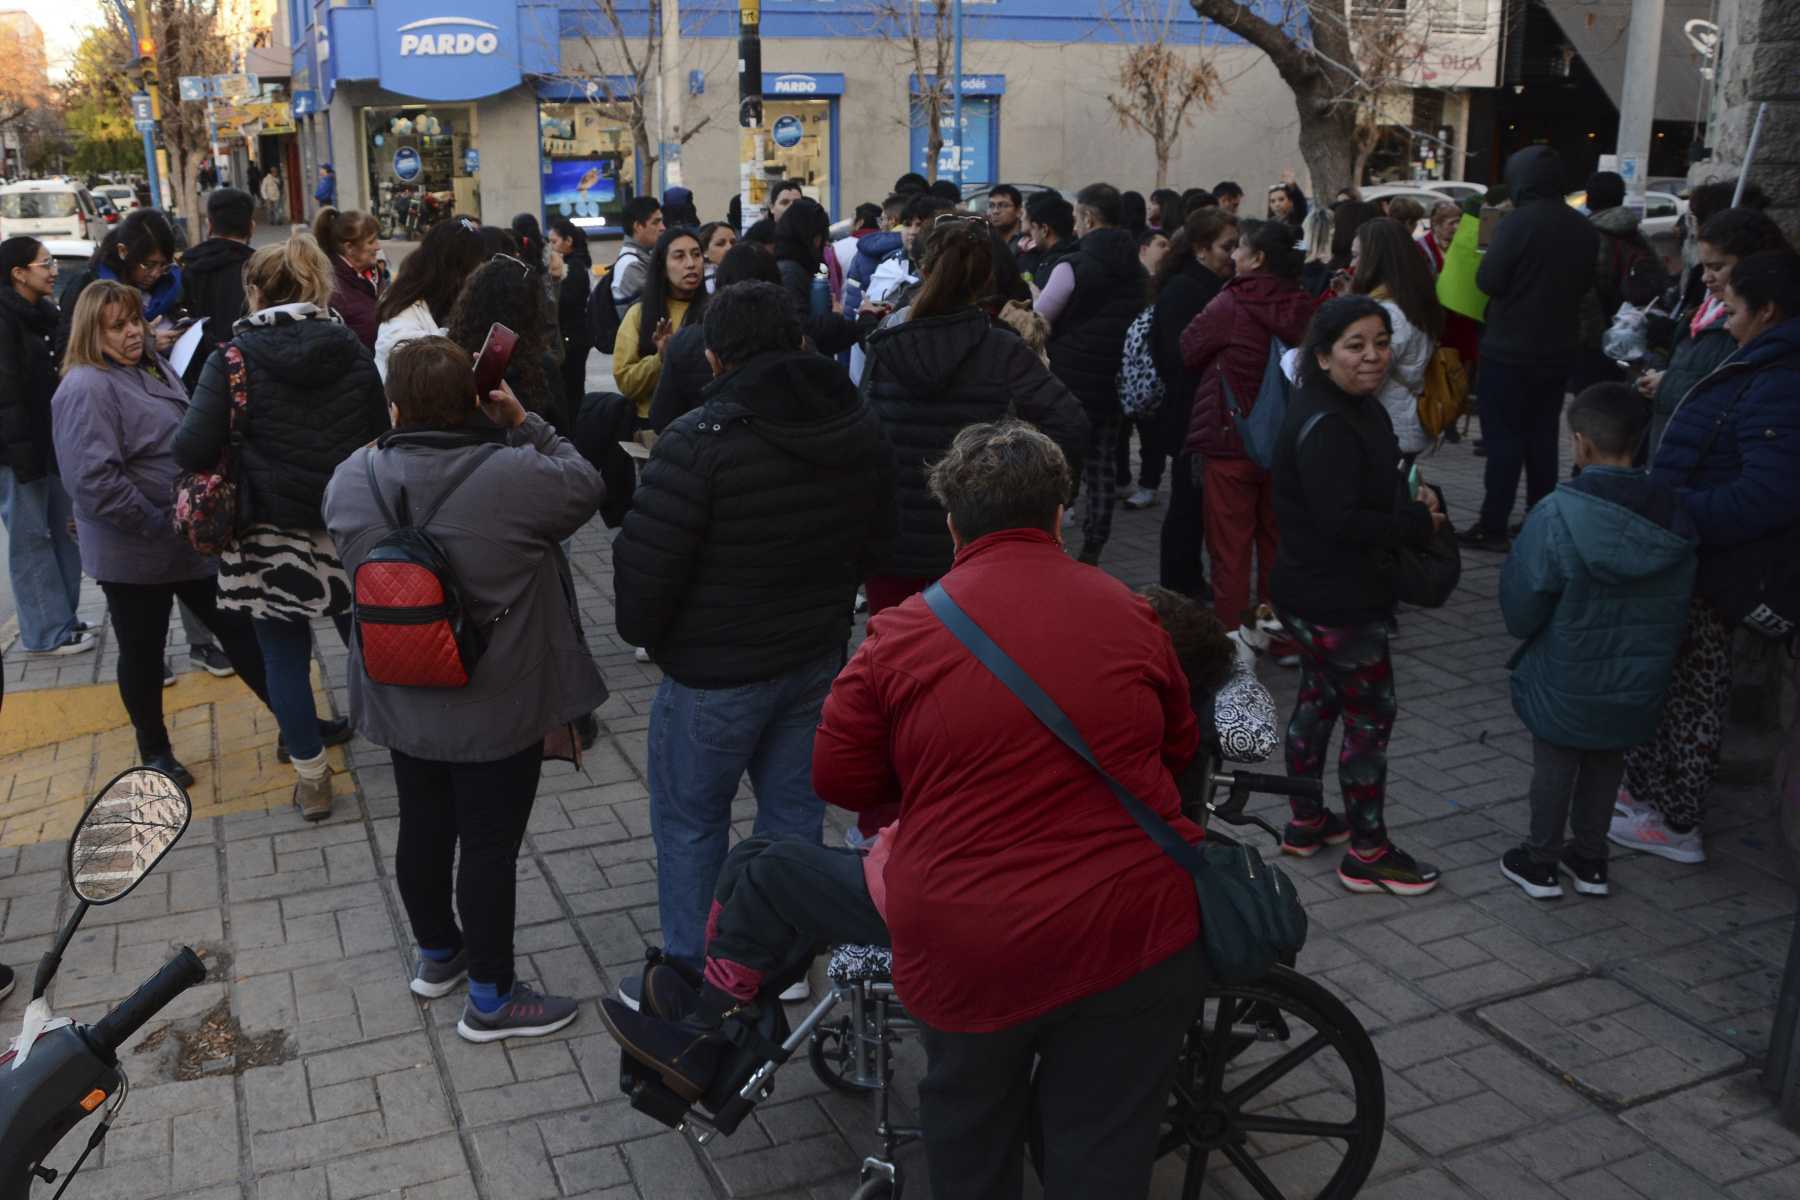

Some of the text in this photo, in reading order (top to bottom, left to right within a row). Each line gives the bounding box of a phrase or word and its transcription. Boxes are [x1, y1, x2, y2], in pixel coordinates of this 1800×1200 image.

[399, 33, 498, 56] PARDO
[775, 81, 816, 93] PARDO
[1750, 602, 1795, 632] BTS
